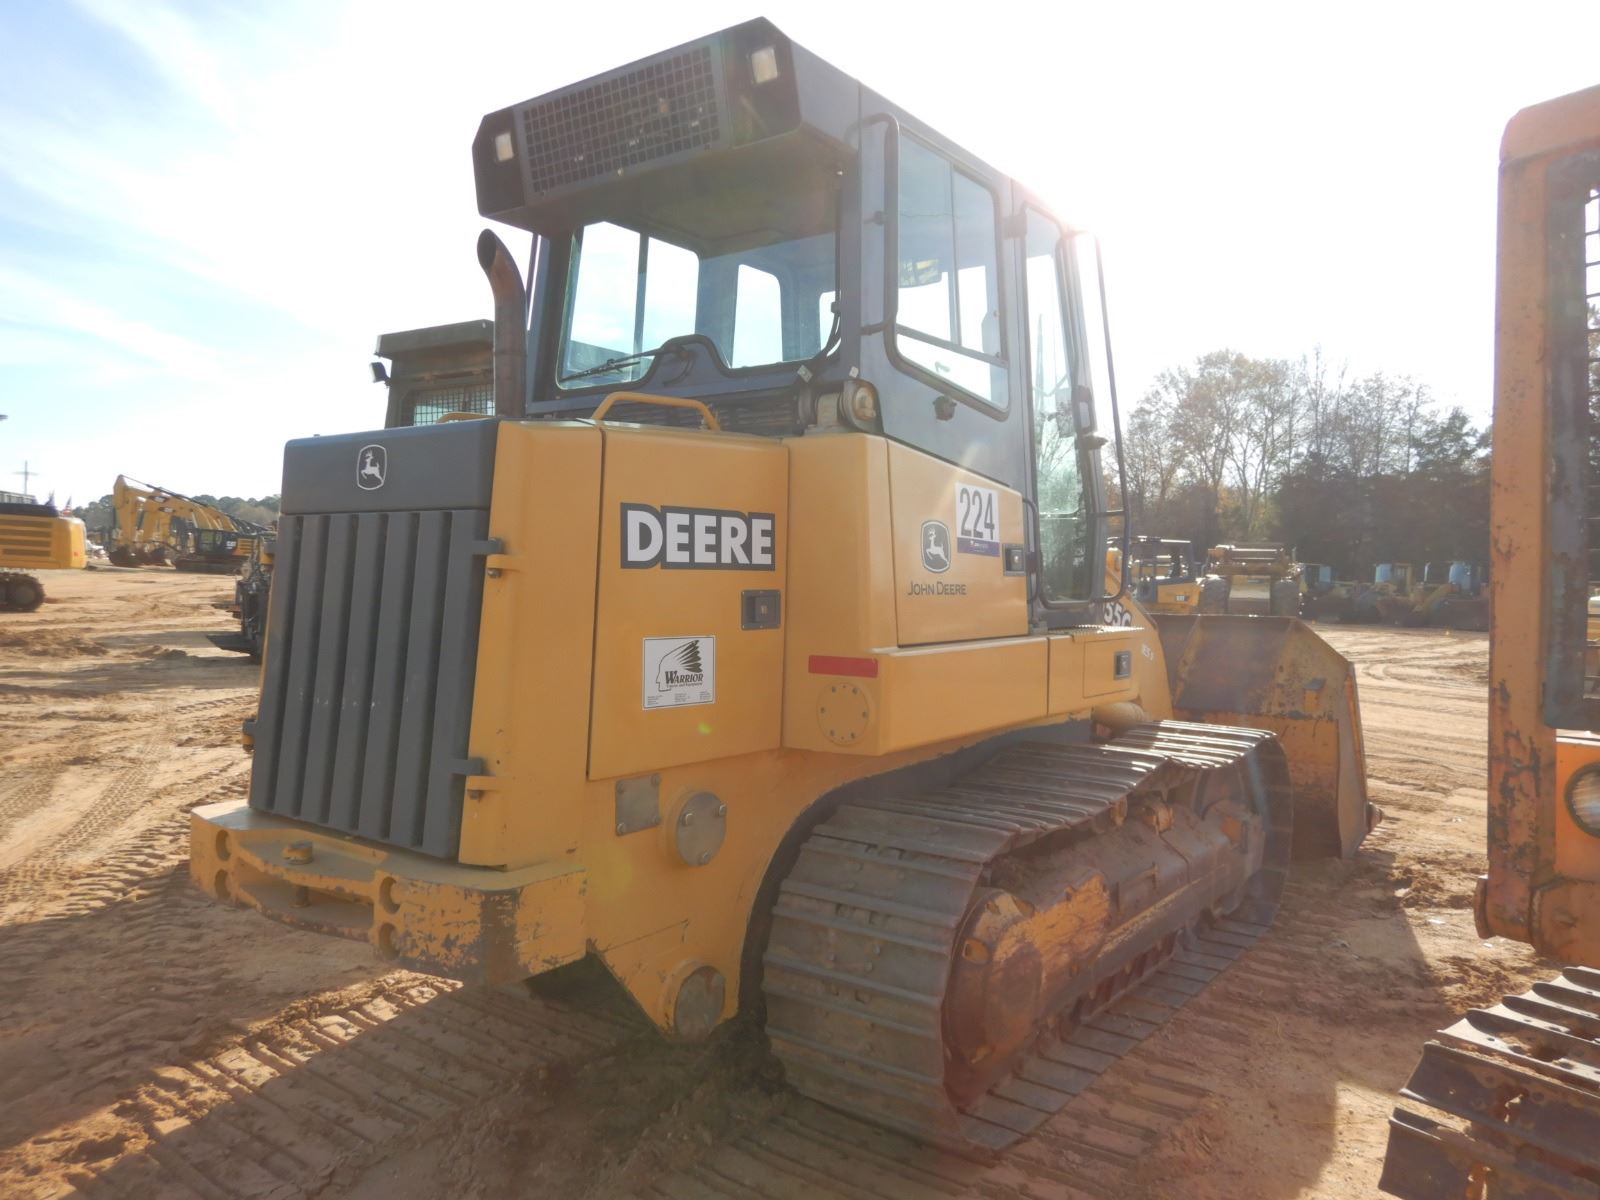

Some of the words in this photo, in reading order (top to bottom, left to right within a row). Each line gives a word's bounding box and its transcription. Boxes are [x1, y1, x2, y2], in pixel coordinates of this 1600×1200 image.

[960, 487, 995, 541] 224
[625, 508, 773, 566] DEERE
[907, 581, 935, 596] JOHN
[936, 581, 967, 596] DEERE
[664, 670, 704, 685] WARRIOR
